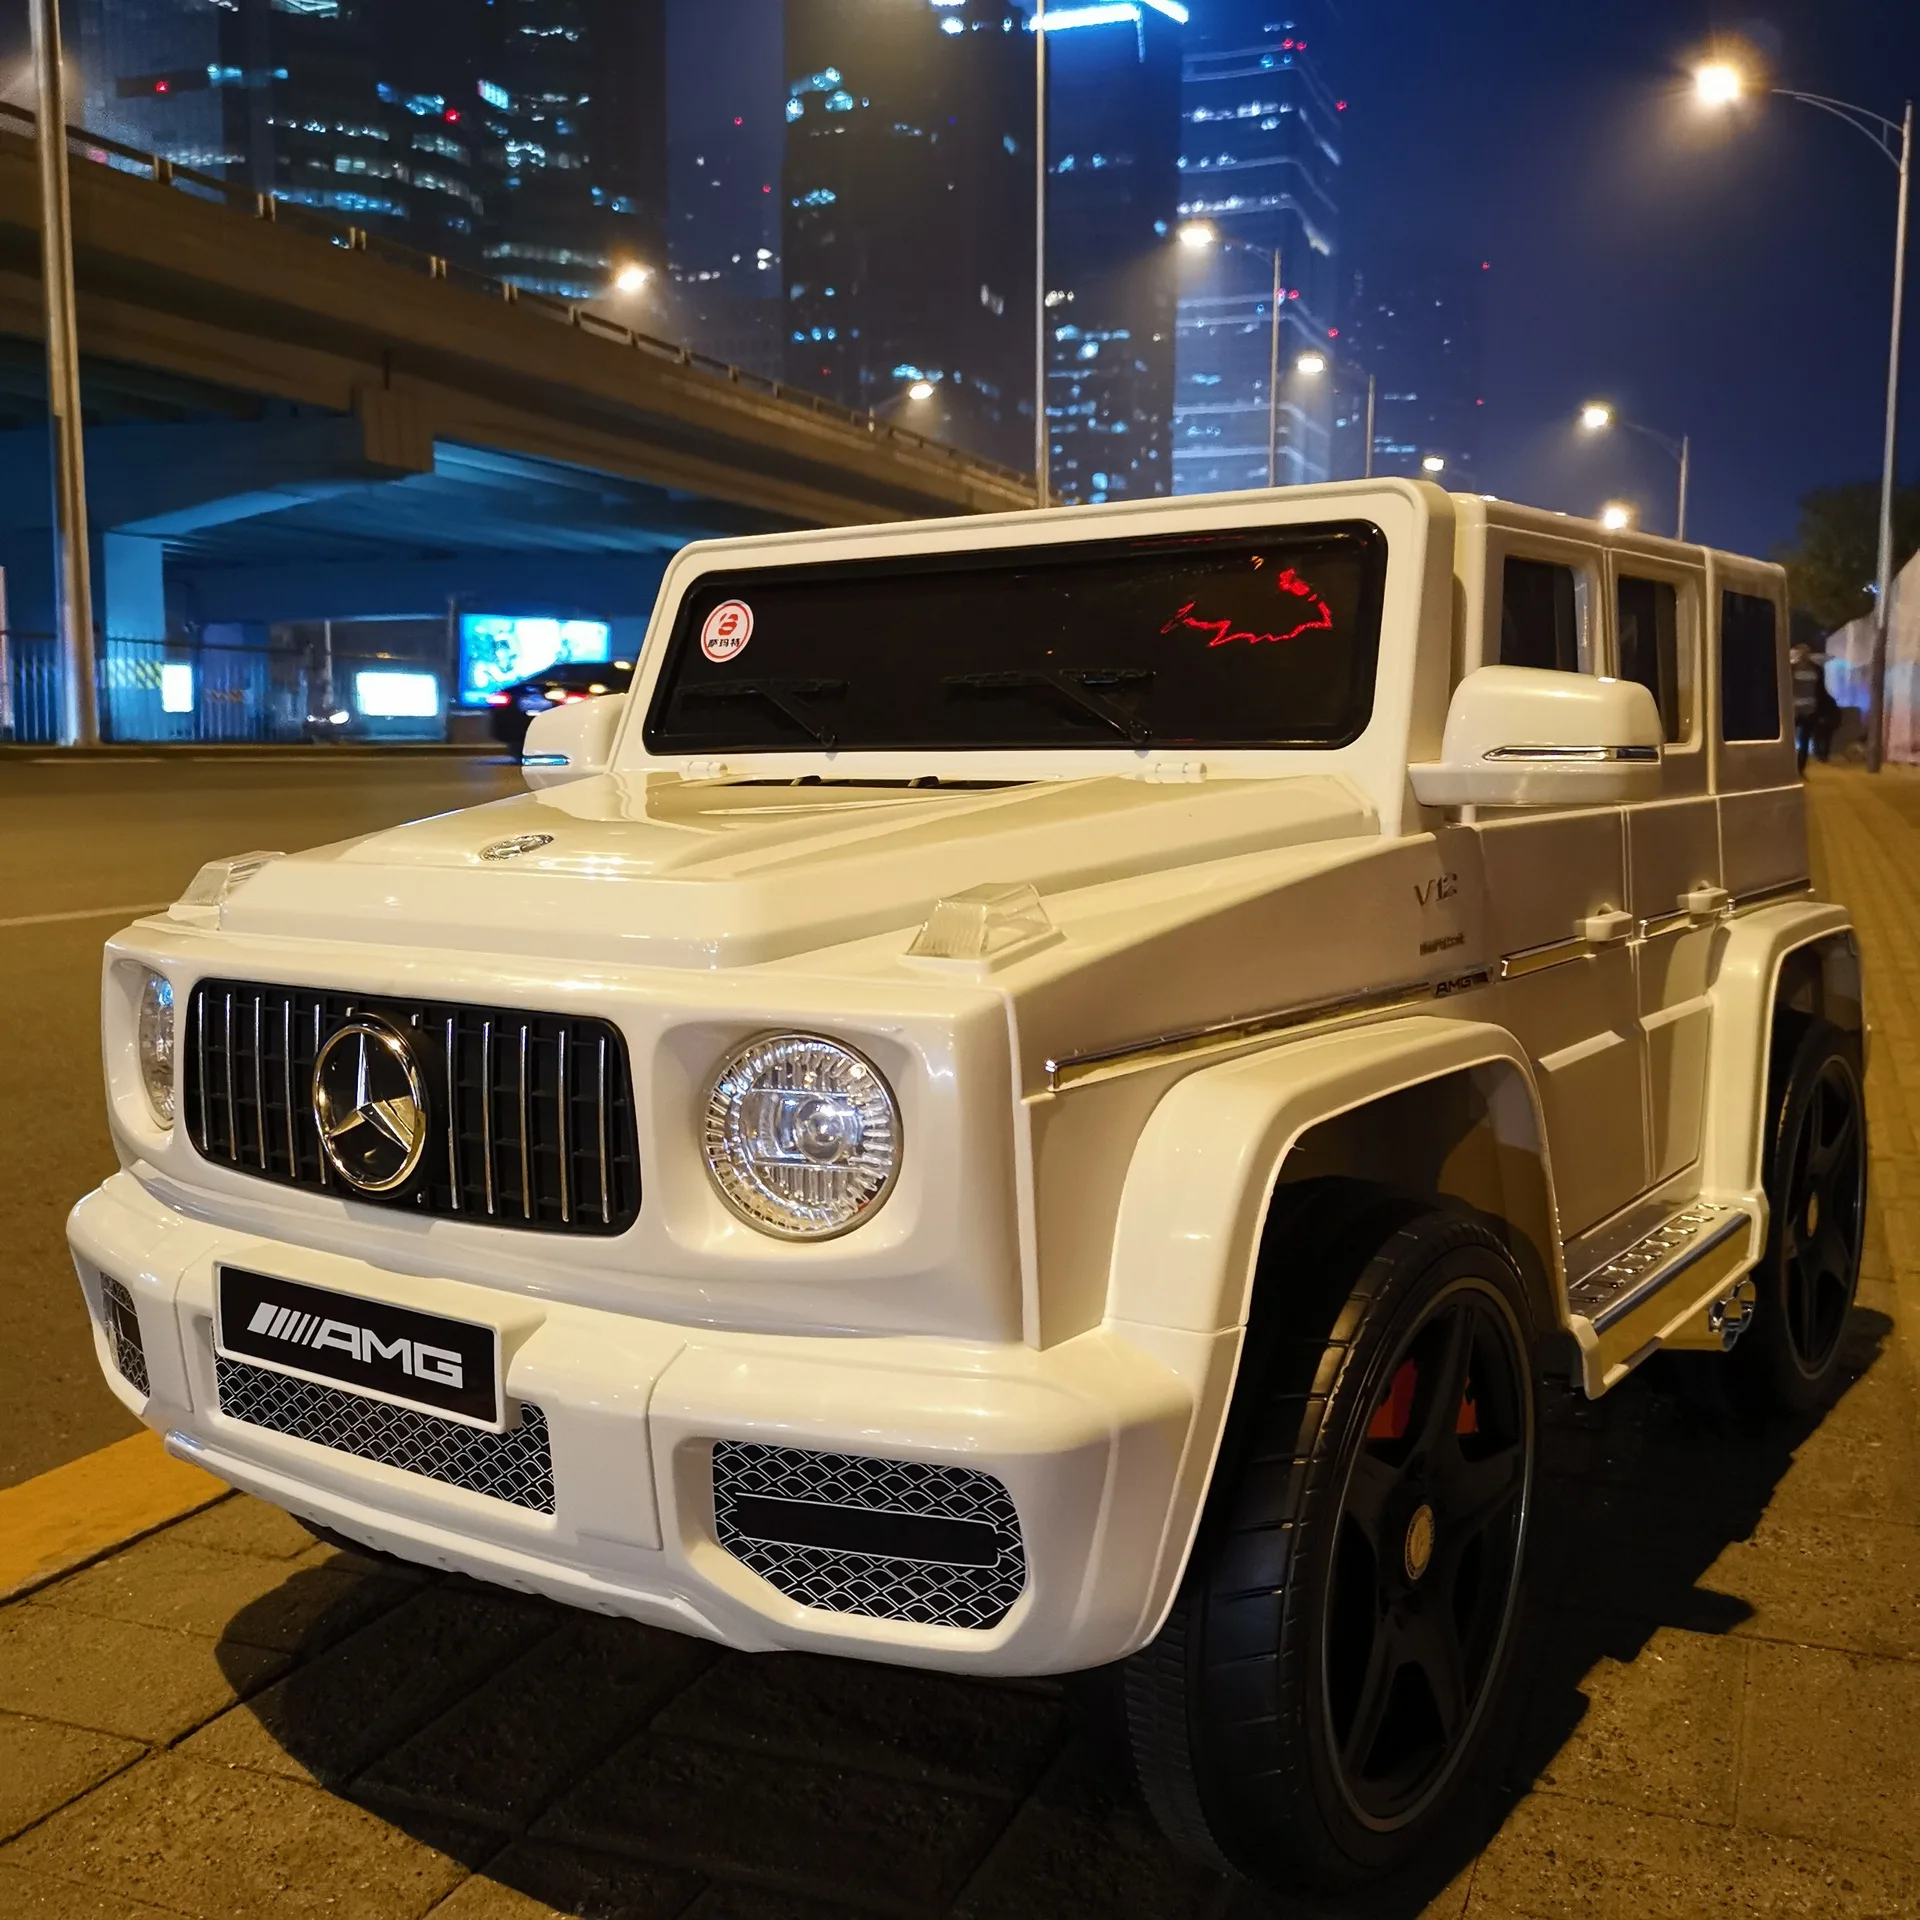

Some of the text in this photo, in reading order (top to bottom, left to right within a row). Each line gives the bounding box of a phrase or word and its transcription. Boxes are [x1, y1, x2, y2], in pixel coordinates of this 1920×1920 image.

[1413, 872, 1458, 906] V12
[1435, 976, 1473, 996] AMG
[311, 1318, 463, 1389] AMG
